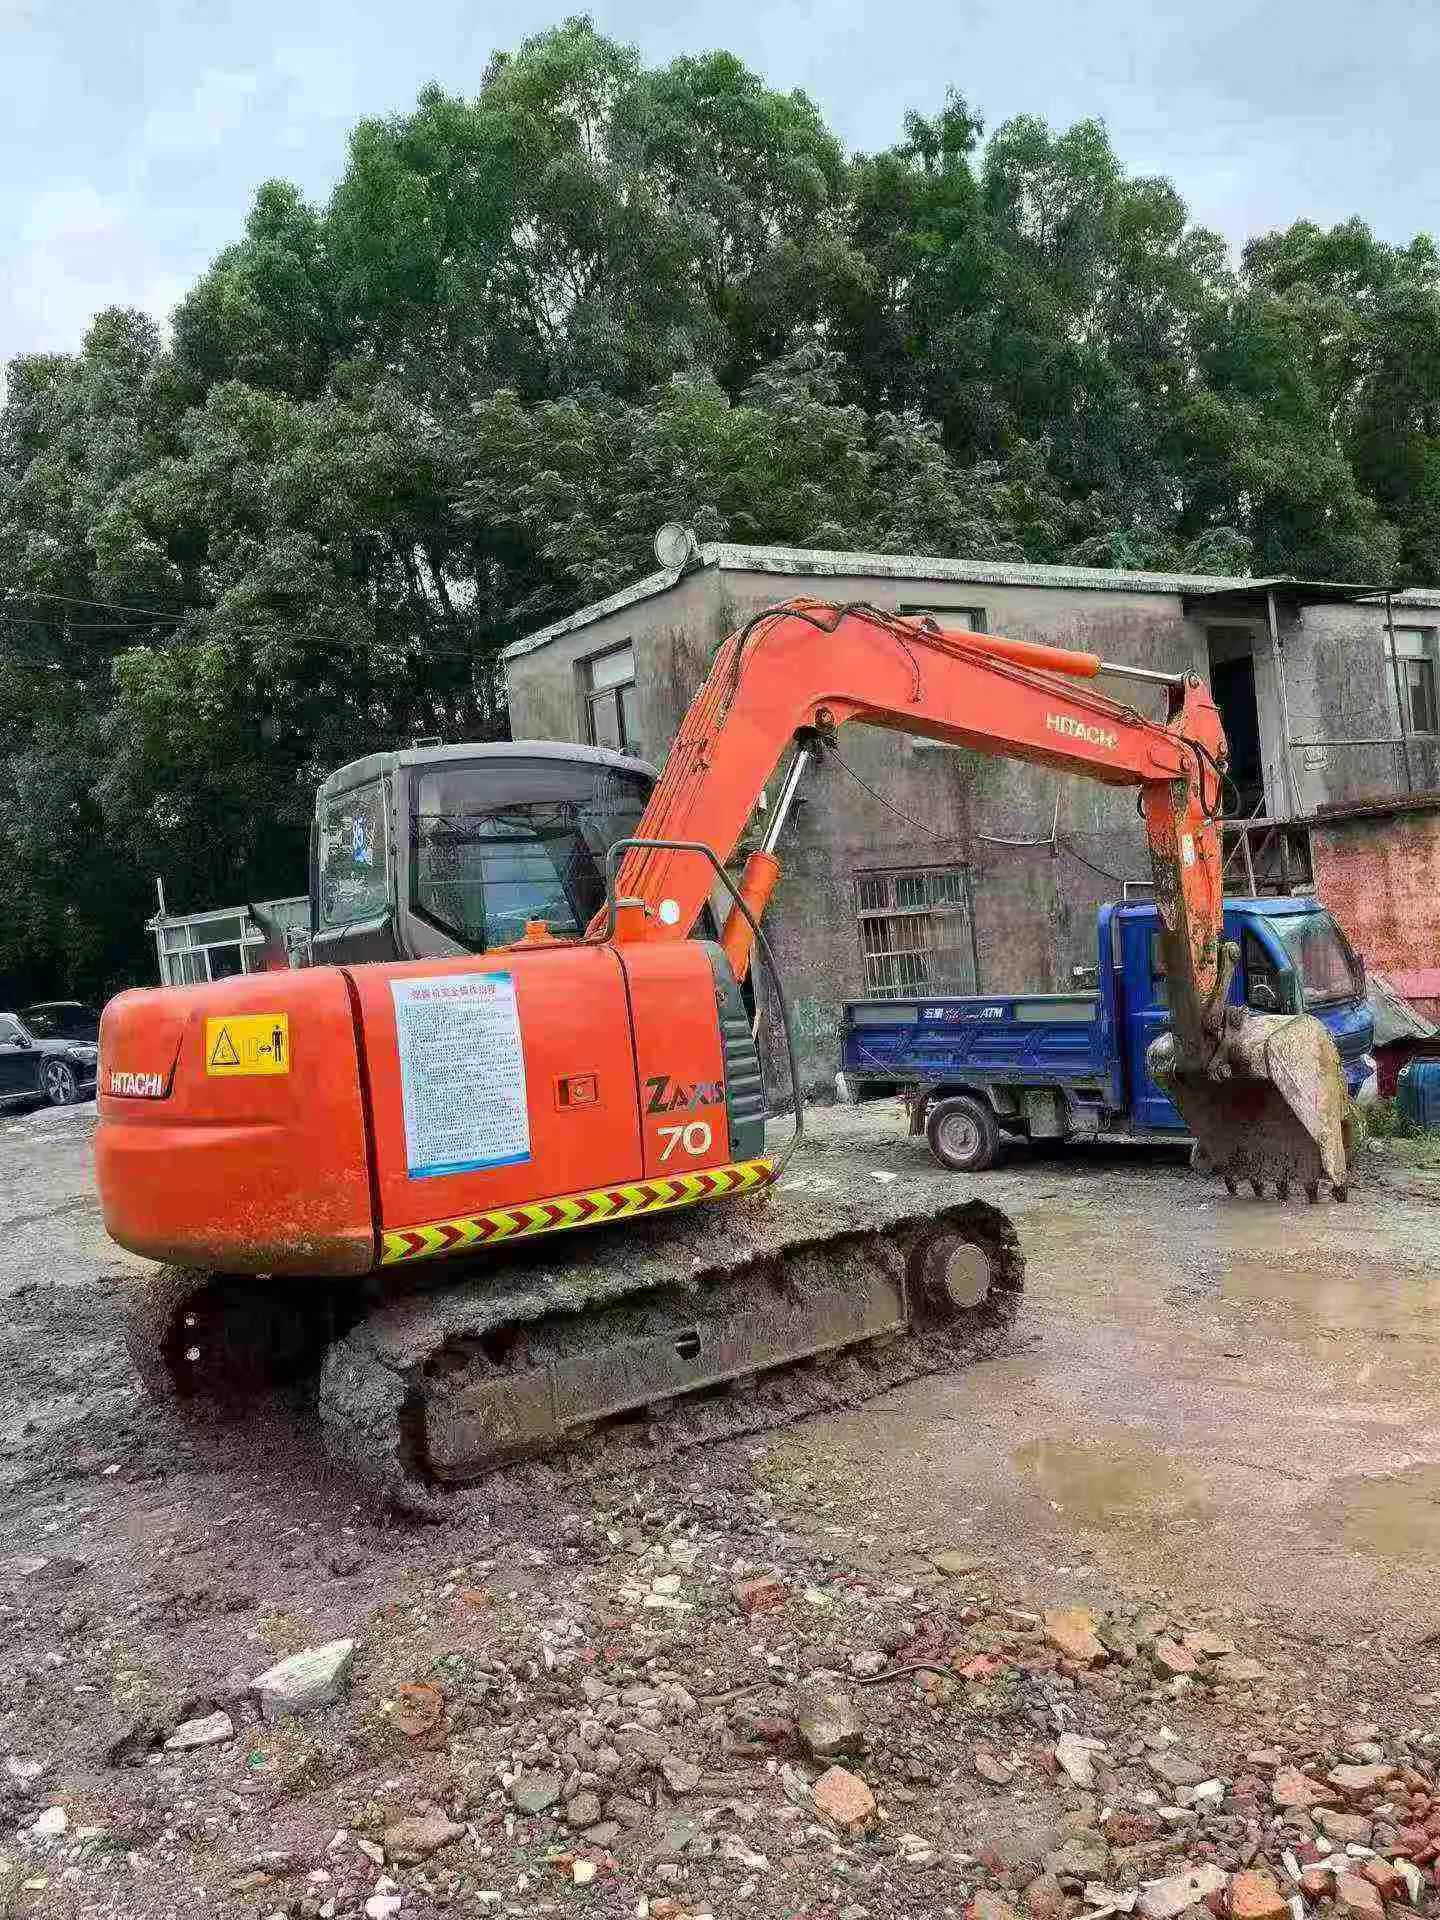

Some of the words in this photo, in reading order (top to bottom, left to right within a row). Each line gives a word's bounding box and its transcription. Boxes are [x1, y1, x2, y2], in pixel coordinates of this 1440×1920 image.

[1046, 712, 1119, 751] HITACHI
[111, 1072, 162, 1096] HITACHI
[657, 1121, 712, 1161] 70
